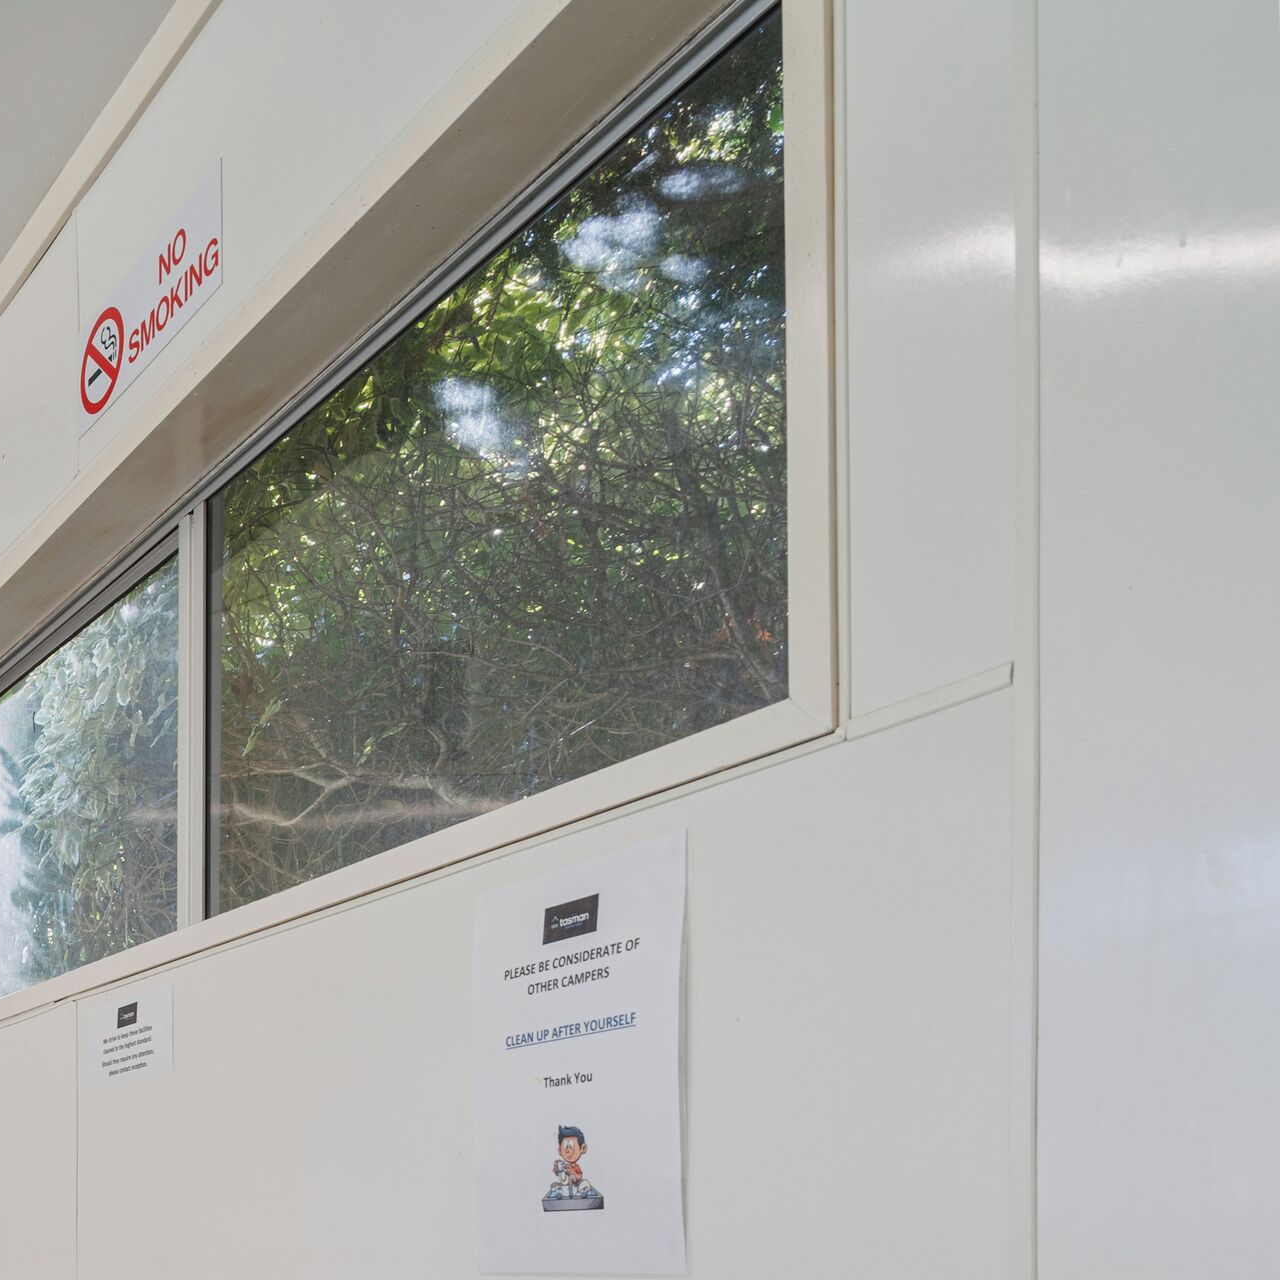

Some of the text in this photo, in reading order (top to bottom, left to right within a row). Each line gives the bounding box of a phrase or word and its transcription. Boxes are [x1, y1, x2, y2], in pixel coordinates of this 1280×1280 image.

[158, 228, 187, 285] NO
[128, 237, 219, 363] SMOKING
[559, 911, 589, 927] tasman
[504, 937, 641, 982] PLEASE BE CONSIDERATE OF
[527, 966, 610, 996] OTHER CAMPERS
[505, 1011, 637, 1049] CLEAN UP AFTER YOURSELF
[543, 1071, 594, 1089] Thank You
